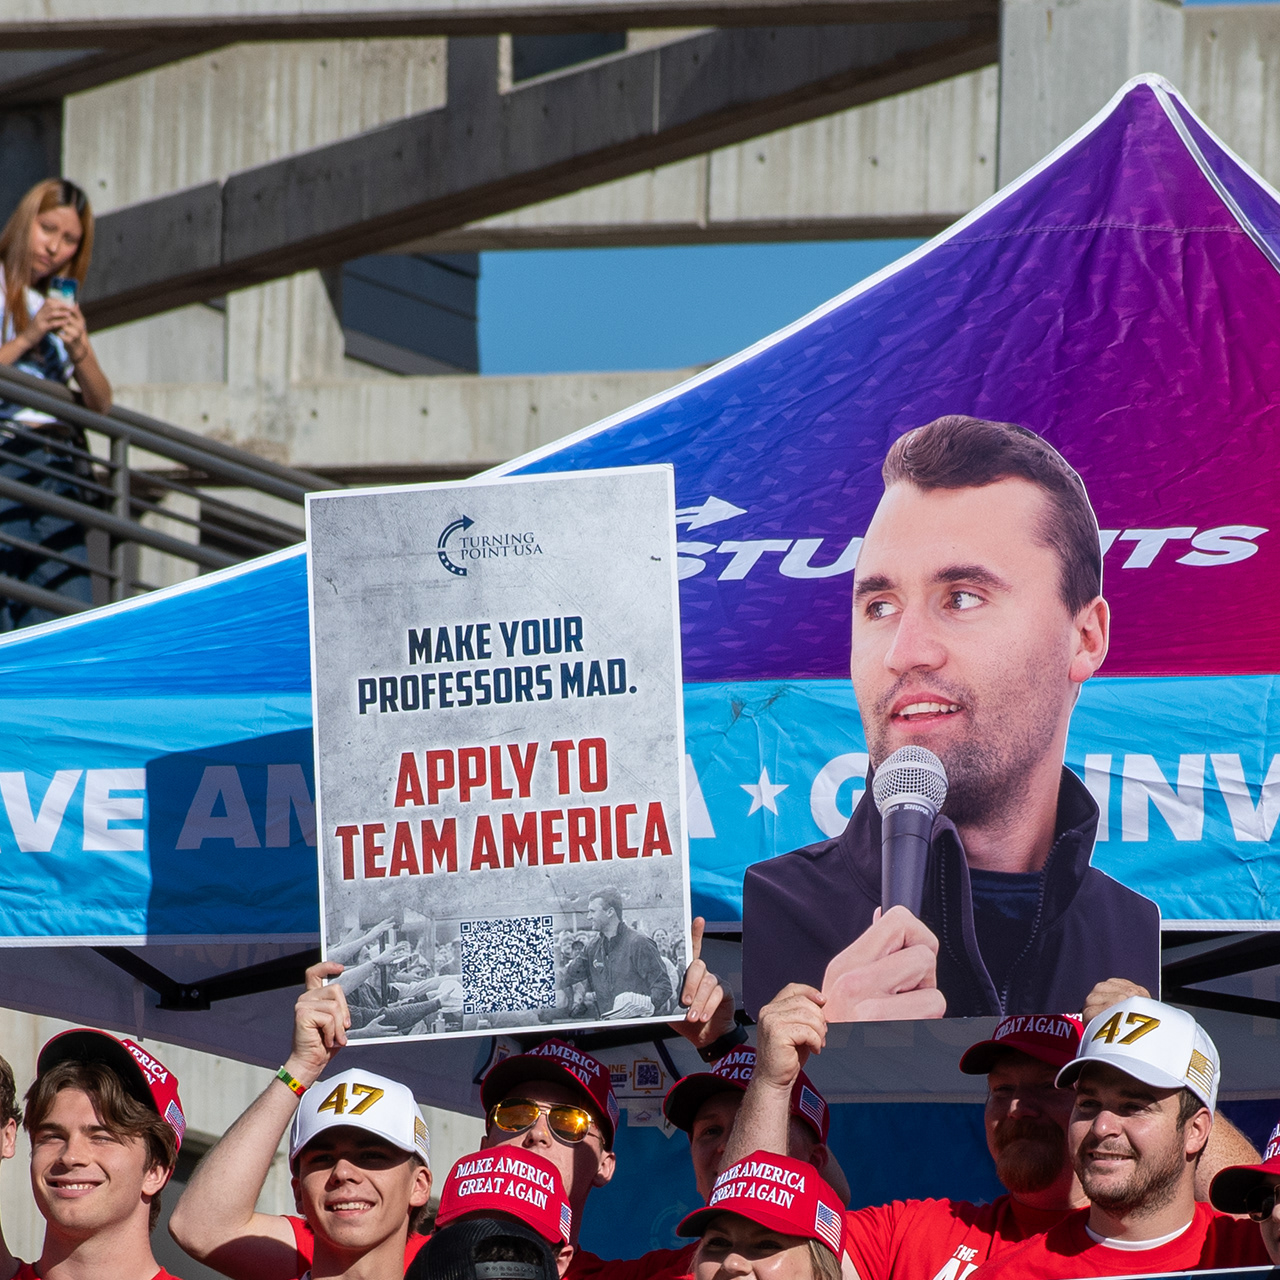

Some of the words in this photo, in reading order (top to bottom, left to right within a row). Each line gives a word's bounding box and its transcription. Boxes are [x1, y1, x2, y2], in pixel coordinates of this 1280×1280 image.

[458, 532, 535, 547] TURNING
[460, 545, 509, 560] POINT
[511, 542, 543, 556] USA
[677, 525, 1269, 581] STUTS
[407, 623, 492, 666] MAKE
[499, 615, 584, 658] YOUR
[358, 664, 553, 715] PROFESSORS
[560, 658, 638, 700] MAD.
[394, 742, 539, 808] APPLY
[550, 737, 609, 796] TO
[334, 817, 458, 881] TEAM
[469, 801, 674, 872] AMERICA
[1024, 1016, 1073, 1040] AGAIN
[1091, 1011, 1161, 1046] 47
[539, 1044, 601, 1078] AMERICA
[317, 1082, 385, 1116] 47
[454, 1156, 494, 1181] MAKE
[494, 1156, 556, 1195] AMERICA
[739, 1161, 806, 1194] AMERICA
[457, 1177, 504, 1198] GREAT
[504, 1180, 549, 1210] AGAIN
[709, 1181, 747, 1207] GREAT
[744, 1181, 795, 1210] AGAIN
[955, 1245, 979, 1263] THE
